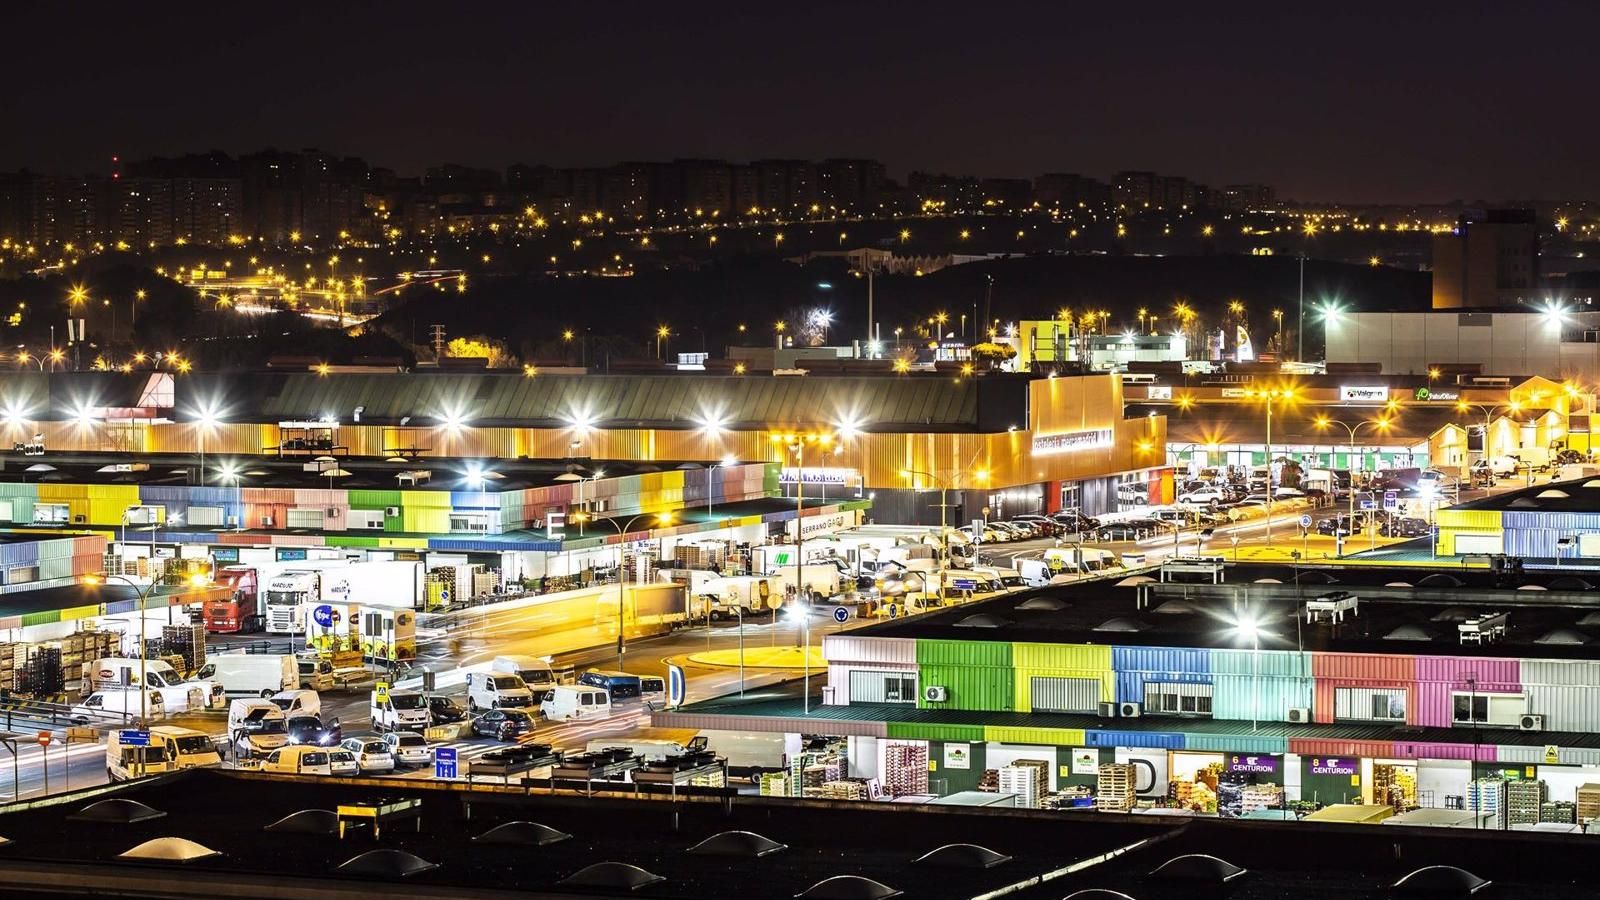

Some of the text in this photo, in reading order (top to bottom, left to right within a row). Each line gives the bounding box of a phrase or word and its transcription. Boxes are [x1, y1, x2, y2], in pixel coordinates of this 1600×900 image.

[547, 513, 565, 539] E
[802, 522, 827, 534] SERRANO
[1232, 756, 1239, 764] 6
[1313, 758, 1319, 767] 8
[1232, 764, 1273, 772] CENTURION
[1312, 767, 1353, 775] CENTURION
